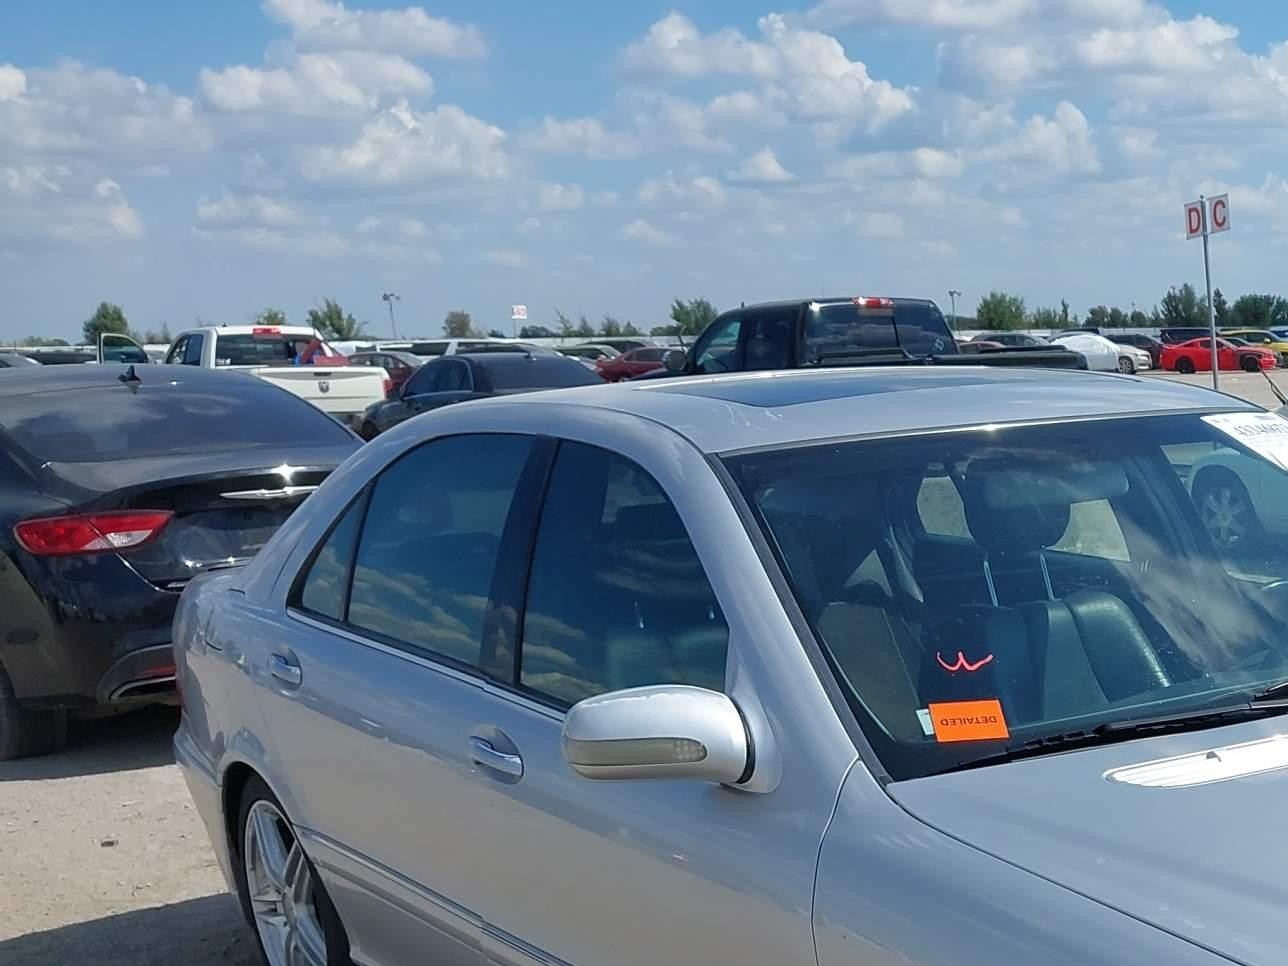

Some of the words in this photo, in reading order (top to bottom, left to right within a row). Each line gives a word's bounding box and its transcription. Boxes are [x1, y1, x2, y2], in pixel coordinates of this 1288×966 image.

[1188, 207, 1201, 234] D
[1213, 199, 1227, 228] C
[940, 715, 997, 726] DETAILED
